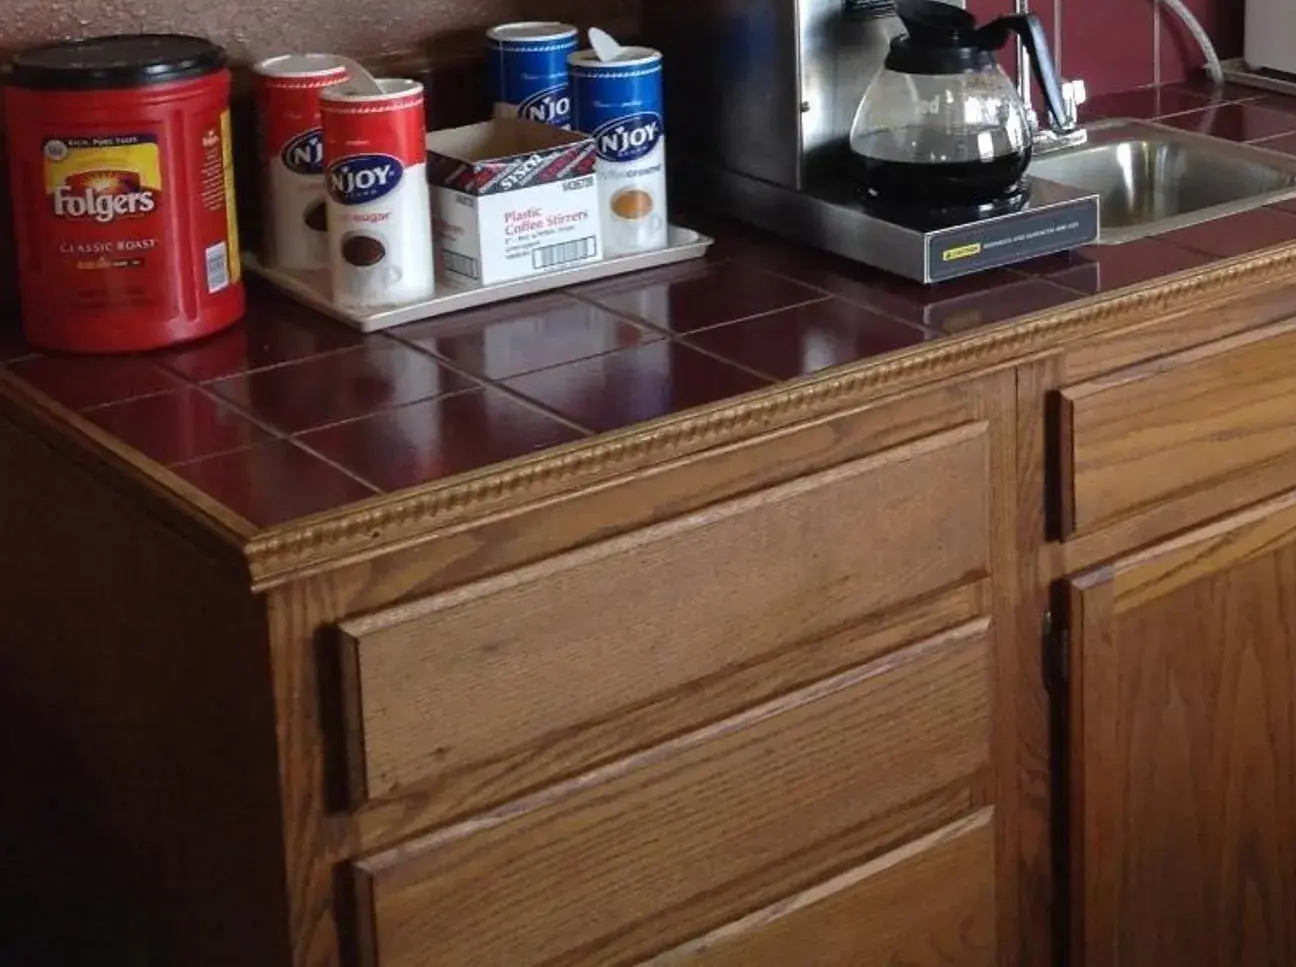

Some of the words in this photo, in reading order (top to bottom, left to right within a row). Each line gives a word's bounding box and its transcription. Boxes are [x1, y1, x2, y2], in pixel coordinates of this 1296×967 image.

[54, 184, 155, 222] Folgers
[504, 208, 541, 223] Plastic
[60, 241, 113, 253] CLASSIC
[117, 238, 155, 251] ROAST
